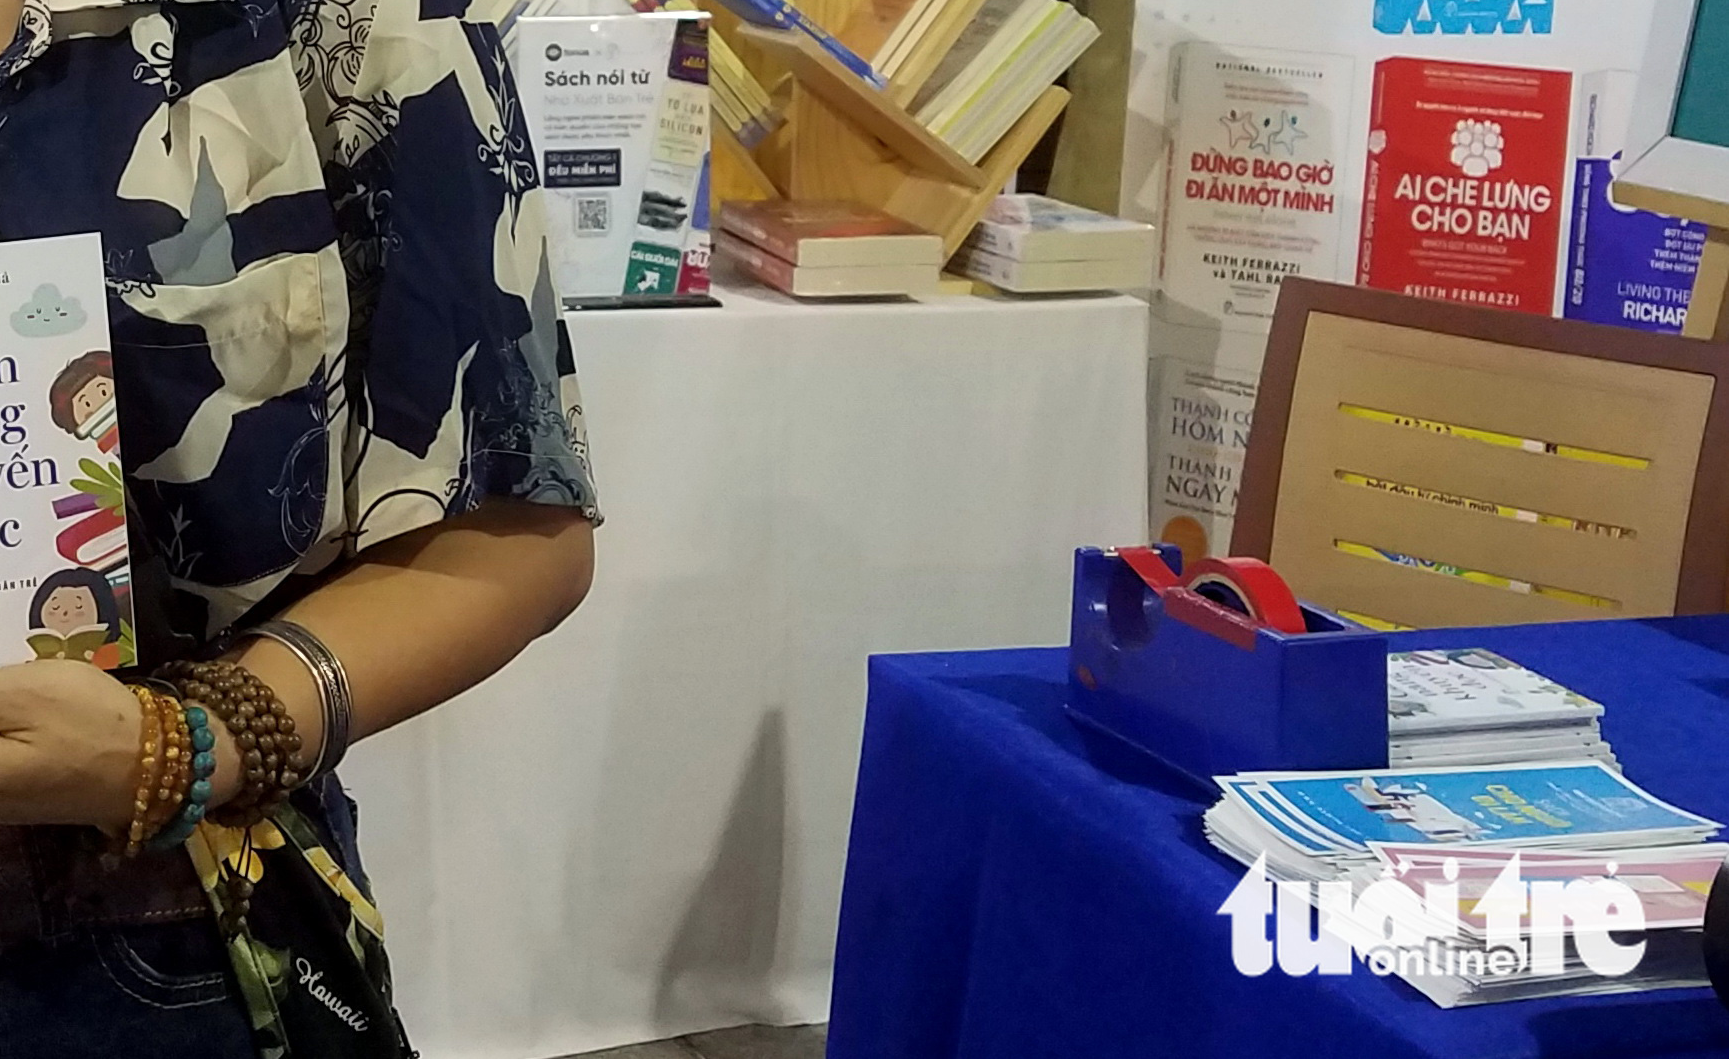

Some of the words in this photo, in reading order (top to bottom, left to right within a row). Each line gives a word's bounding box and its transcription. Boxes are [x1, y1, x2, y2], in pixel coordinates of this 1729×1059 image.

[545, 71, 590, 86] Sách
[597, 69, 624, 85] nói
[631, 69, 650, 84] từ
[660, 118, 703, 135] SILICON
[1191, 148, 1248, 176] ĐỪNG
[1253, 159, 1291, 181] BAO
[1295, 159, 1334, 186] GIỜ
[1186, 180, 1205, 198] ĐI
[1208, 180, 1235, 202] ĂN
[1238, 183, 1280, 212] MỘT
[1283, 185, 1333, 213] MÌNH
[1395, 174, 1421, 201] AI
[1425, 176, 1477, 207] CHE
[1483, 179, 1551, 213] LƯNG
[1411, 205, 1471, 235] CHO
[1477, 210, 1530, 242] BẠN
[1203, 253, 1238, 267] KEITH
[1242, 256, 1300, 274] FERRAZZI
[1231, 270, 1261, 283] TAHL
[1404, 284, 1446, 298] KEITH
[1453, 288, 1519, 306] FERRAZZI
[1618, 282, 1661, 300] LIVING
[1664, 287, 1691, 304] THE
[1623, 301, 1689, 326] RICHAR
[296, 957, 368, 1032] Hawaii
